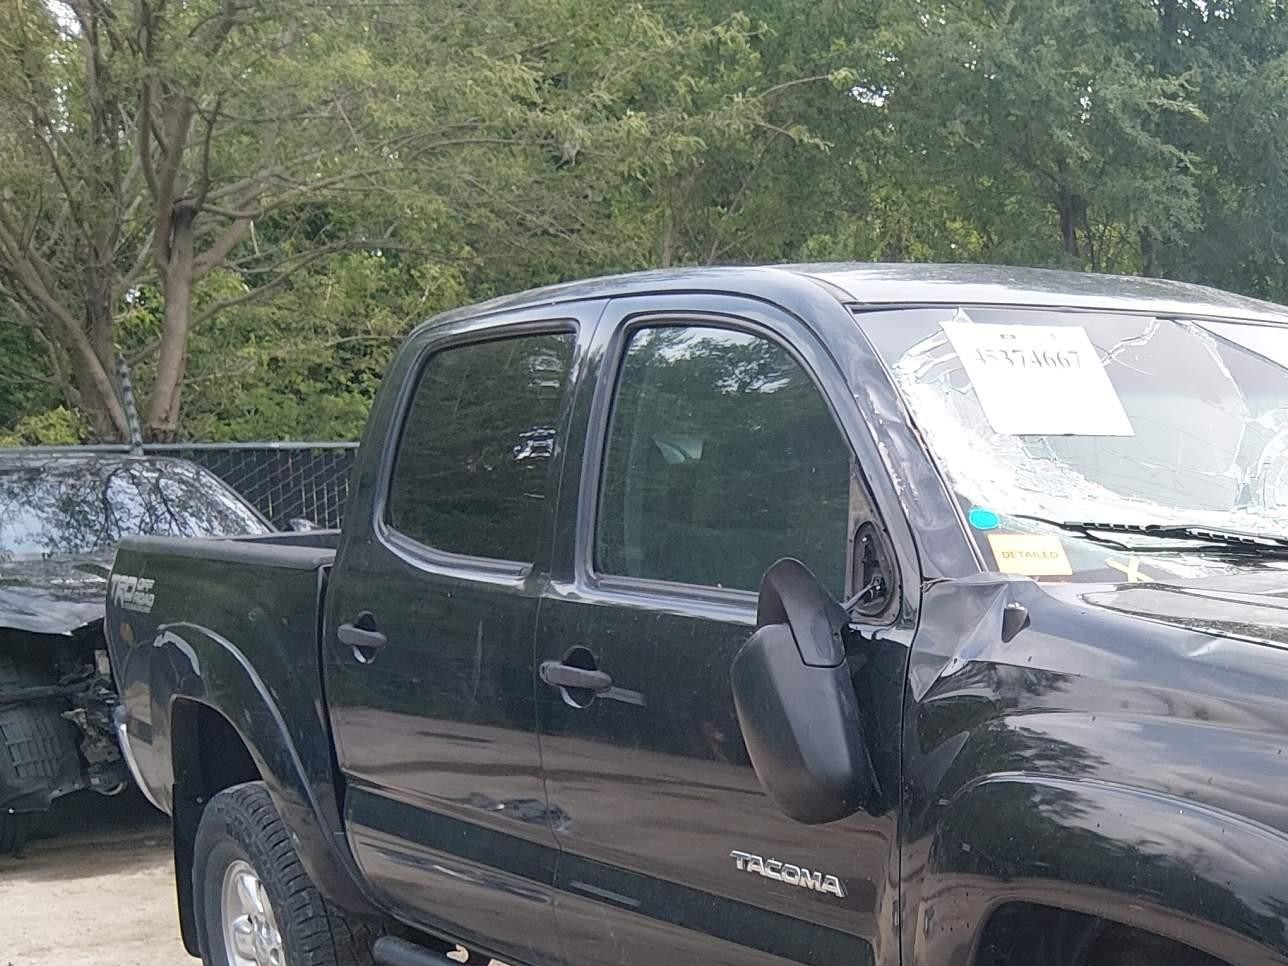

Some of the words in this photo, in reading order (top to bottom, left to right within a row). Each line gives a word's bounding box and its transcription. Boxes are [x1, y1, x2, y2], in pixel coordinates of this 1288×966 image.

[1001, 551, 1059, 559] DETAILED
[110, 574, 138, 608] TRD
[729, 850, 848, 898] TACOMA
